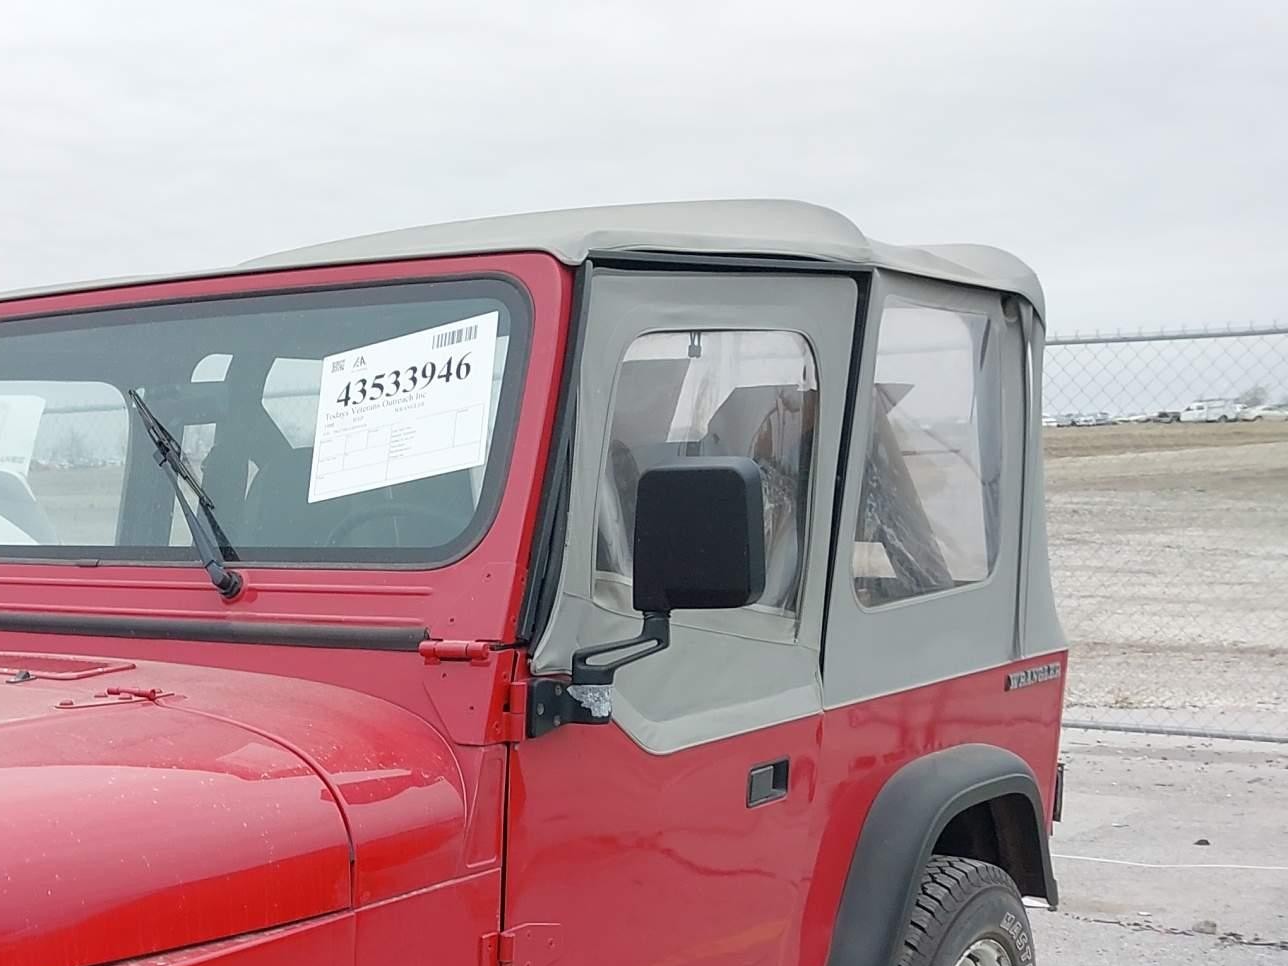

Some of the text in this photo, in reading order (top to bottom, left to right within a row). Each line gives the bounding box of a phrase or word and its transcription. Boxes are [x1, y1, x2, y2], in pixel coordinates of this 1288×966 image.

[336, 351, 472, 407] 43533946
[352, 402, 381, 415] Veterans
[382, 394, 414, 408] Outreach
[1008, 662, 1061, 689] WRANGLER
